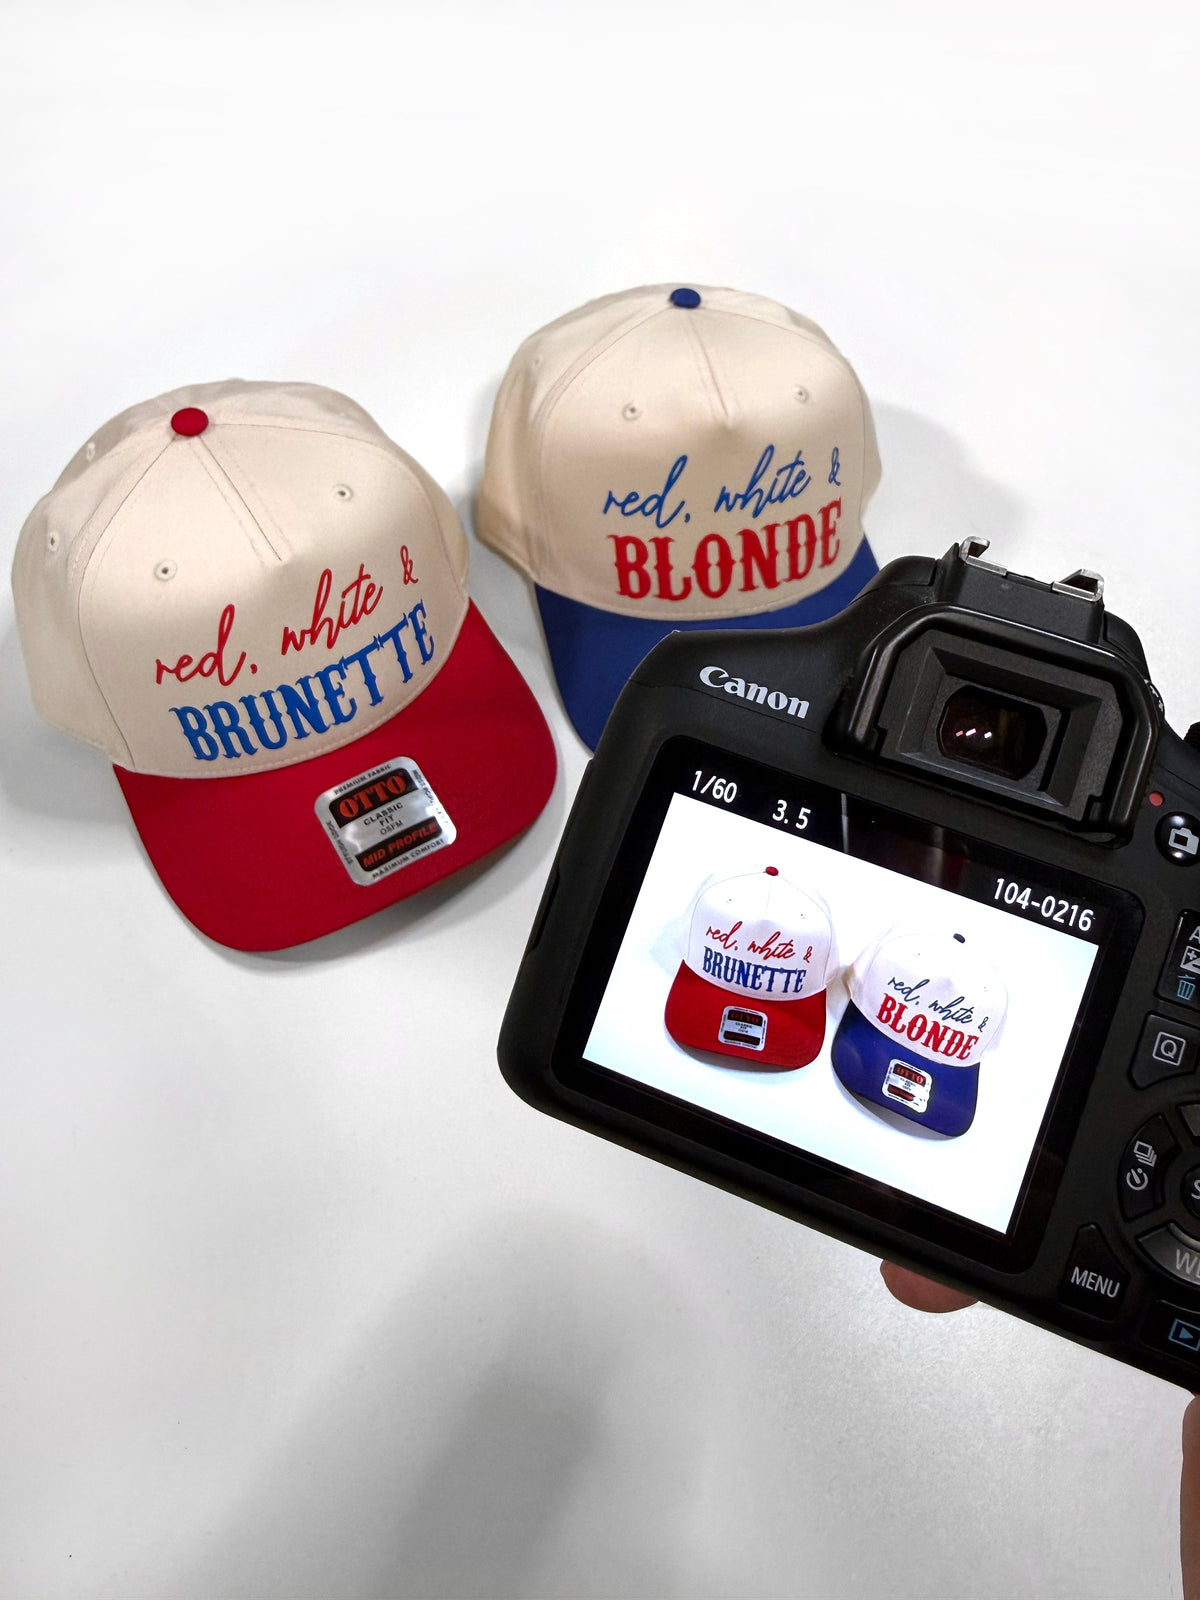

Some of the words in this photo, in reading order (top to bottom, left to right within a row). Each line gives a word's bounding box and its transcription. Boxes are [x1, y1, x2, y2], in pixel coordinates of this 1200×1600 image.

[603, 454, 691, 529] red,
[713, 443, 812, 519] white
[828, 446, 841, 486] &
[606, 496, 842, 602] BLONDE
[155, 603, 258, 686] red,
[281, 568, 383, 656] white
[400, 545, 418, 585] &
[168, 598, 435, 761] BRUNETTE
[699, 665, 810, 719] Canon
[334, 776, 367, 795] PREMIUM
[367, 764, 392, 779] FABRIC
[339, 775, 406, 818] OTTO
[692, 770, 738, 803] 1/60
[363, 802, 404, 826] CLASSIC
[380, 814, 395, 826] FIT
[380, 820, 403, 836] OSFM
[362, 849, 386, 868] MID
[388, 822, 437, 855] PROFILE
[372, 856, 410, 879] MAXIMUM
[411, 839, 444, 858] COMFORT
[994, 878, 1095, 932] 104-0216
[705, 920, 743, 951] red,
[747, 931, 796, 961] white
[803, 946, 813, 963] &
[702, 946, 807, 994] BRUNETTE
[875, 992, 980, 1061] BLONDE
[887, 976, 931, 1006] red,
[928, 996, 975, 1024] white
[977, 1016, 989, 1033] &
[1159, 1039, 1177, 1059] Q
[1070, 1265, 1121, 1298] MENU
